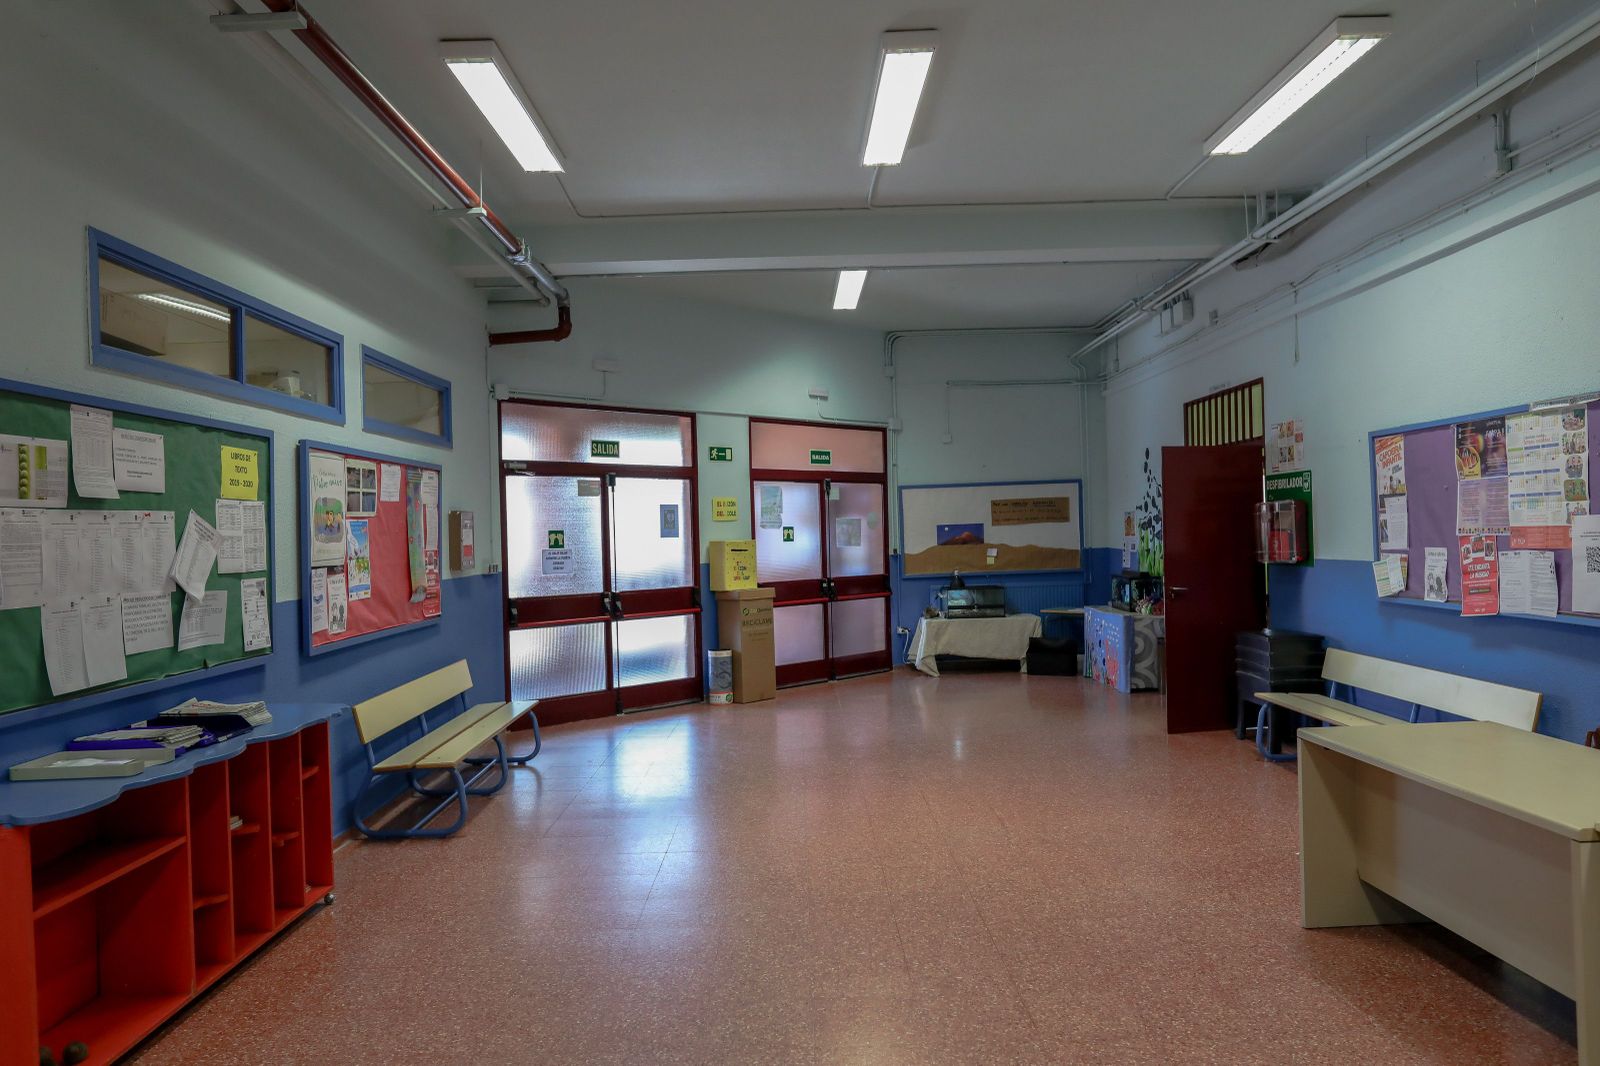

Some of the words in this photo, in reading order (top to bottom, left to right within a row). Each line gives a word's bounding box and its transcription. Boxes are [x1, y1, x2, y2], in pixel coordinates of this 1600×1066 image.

[592, 443, 618, 455] SALIDA
[231, 452, 245, 462] LIBROS
[245, 454, 251, 462] DE
[234, 465, 247, 474] TEXTO
[1266, 476, 1303, 490] DESFIBRILADOR
